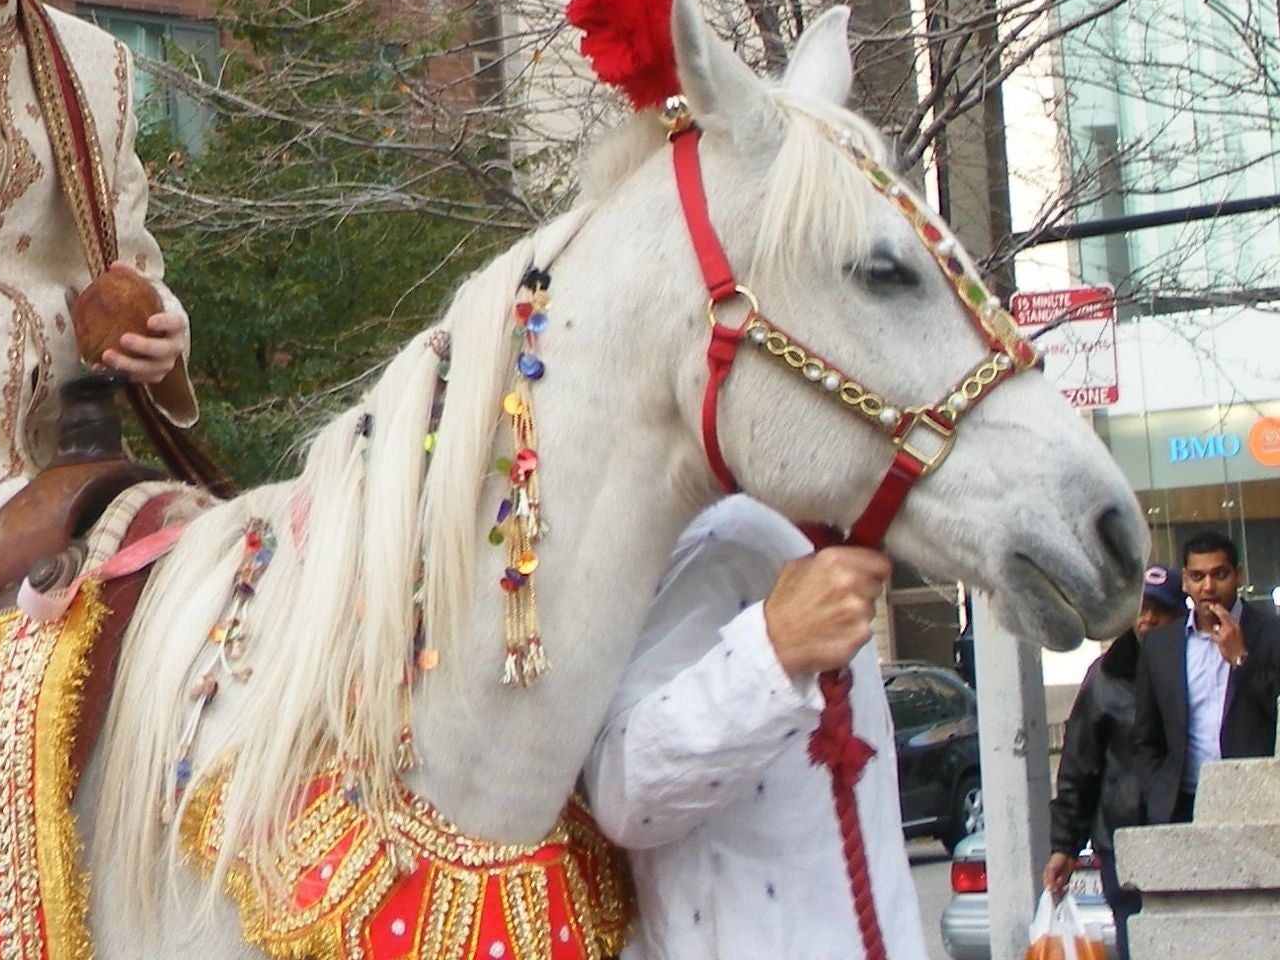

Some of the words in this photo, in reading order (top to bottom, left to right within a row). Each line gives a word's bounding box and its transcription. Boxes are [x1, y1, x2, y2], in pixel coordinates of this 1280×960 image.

[1032, 292, 1071, 308] MINUTE
[1065, 387, 1110, 407] ZONE
[1169, 433, 1242, 463] BMO
